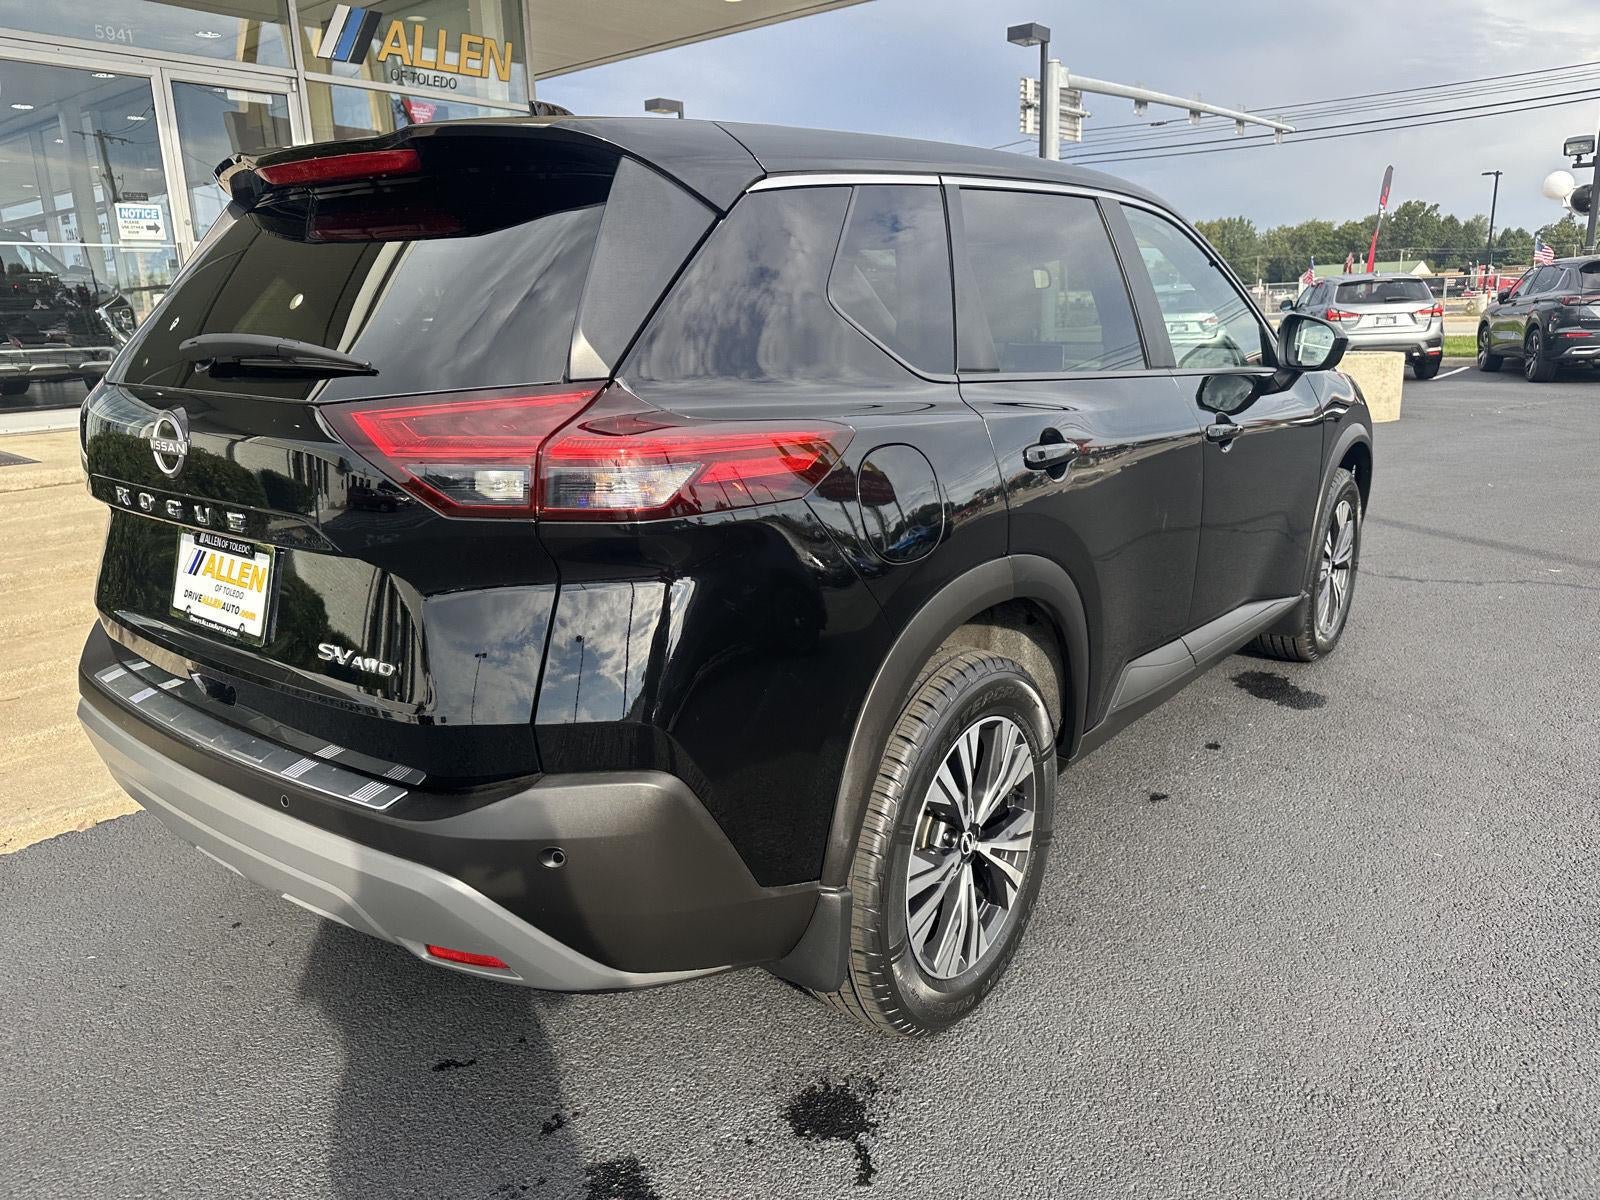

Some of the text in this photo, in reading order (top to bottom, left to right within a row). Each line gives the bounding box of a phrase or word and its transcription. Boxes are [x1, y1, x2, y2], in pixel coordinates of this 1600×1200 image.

[94, 23, 133, 44] 5941
[377, 19, 512, 82] ALLEN
[390, 68, 457, 90] OF TOLEDO
[121, 208, 158, 219] NOTICE
[150, 439, 188, 455] NISSAN
[115, 485, 247, 533] ROGUE
[204, 533, 251, 554] ALLEN OF TOLEDO
[202, 553, 267, 593] ALLEN
[214, 584, 245, 600] OF TOLEDO
[317, 642, 396, 677] SV AWD
